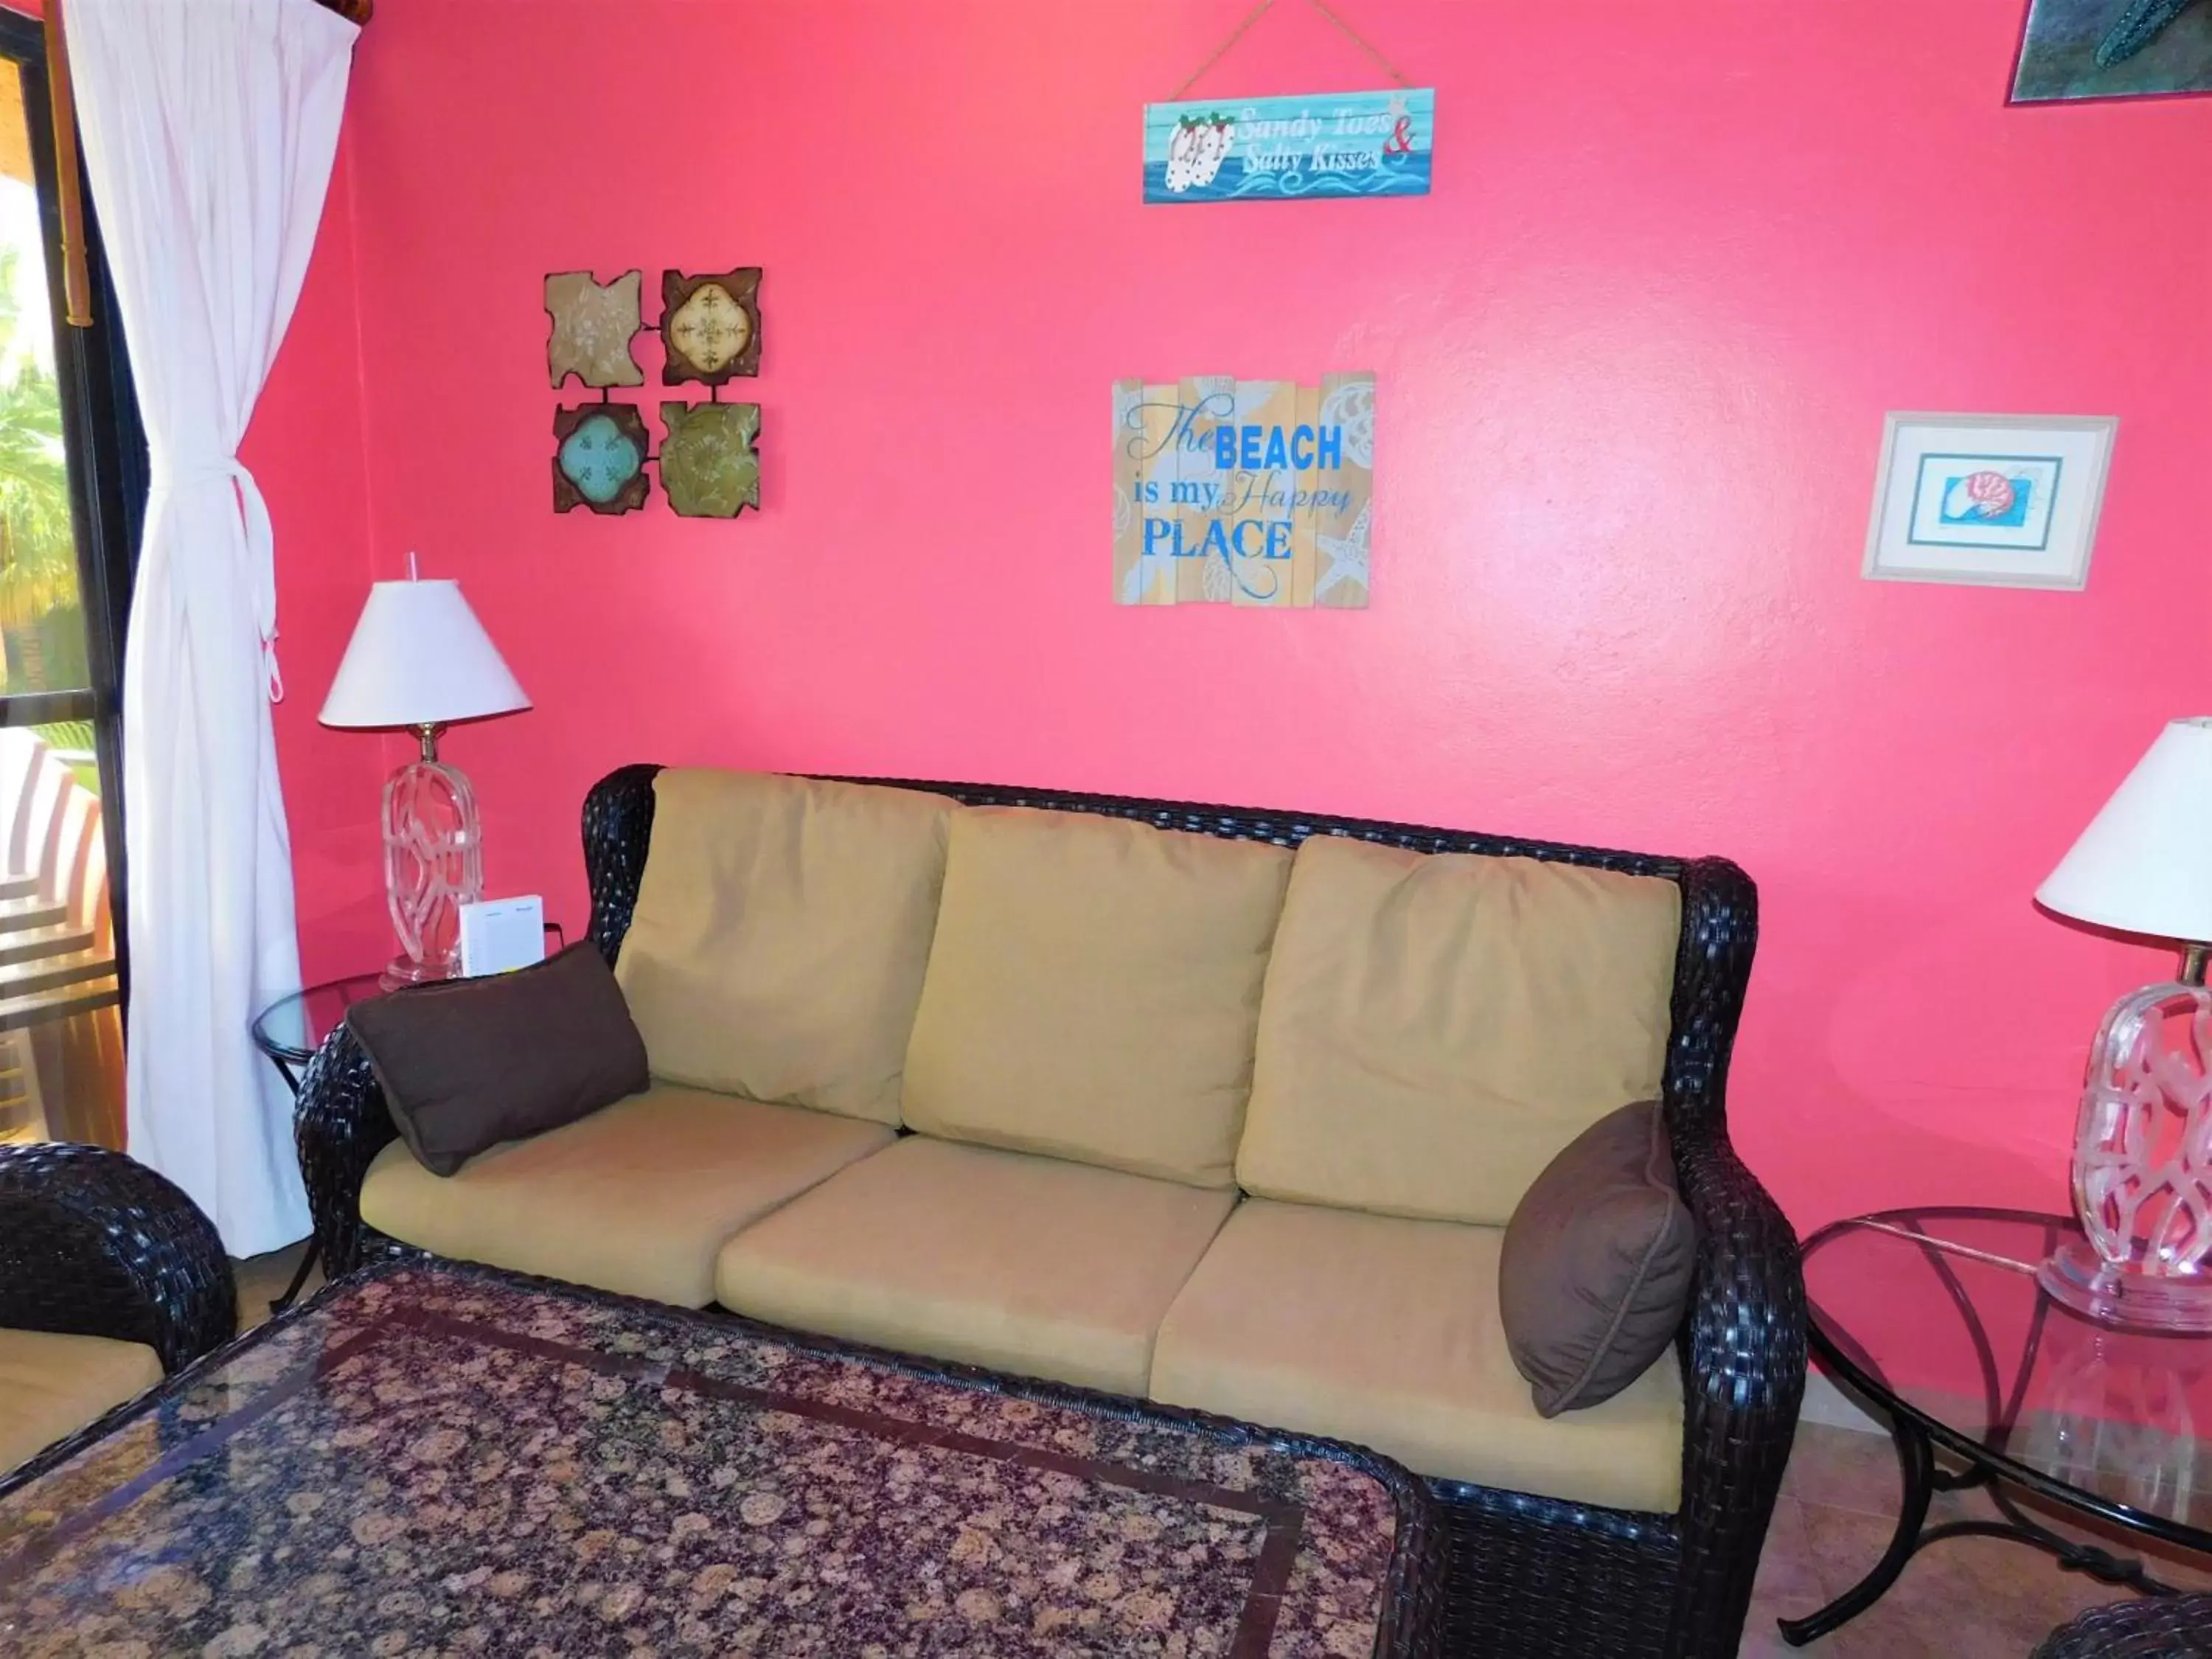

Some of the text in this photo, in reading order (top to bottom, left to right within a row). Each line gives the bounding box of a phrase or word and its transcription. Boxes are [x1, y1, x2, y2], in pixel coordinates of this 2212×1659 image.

[1239, 108, 1416, 154] Sandy Toes &
[1242, 143, 1383, 173] Salty Kisses
[1126, 393, 1343, 470] The BEACH
[1133, 470, 1351, 519] is my Happy
